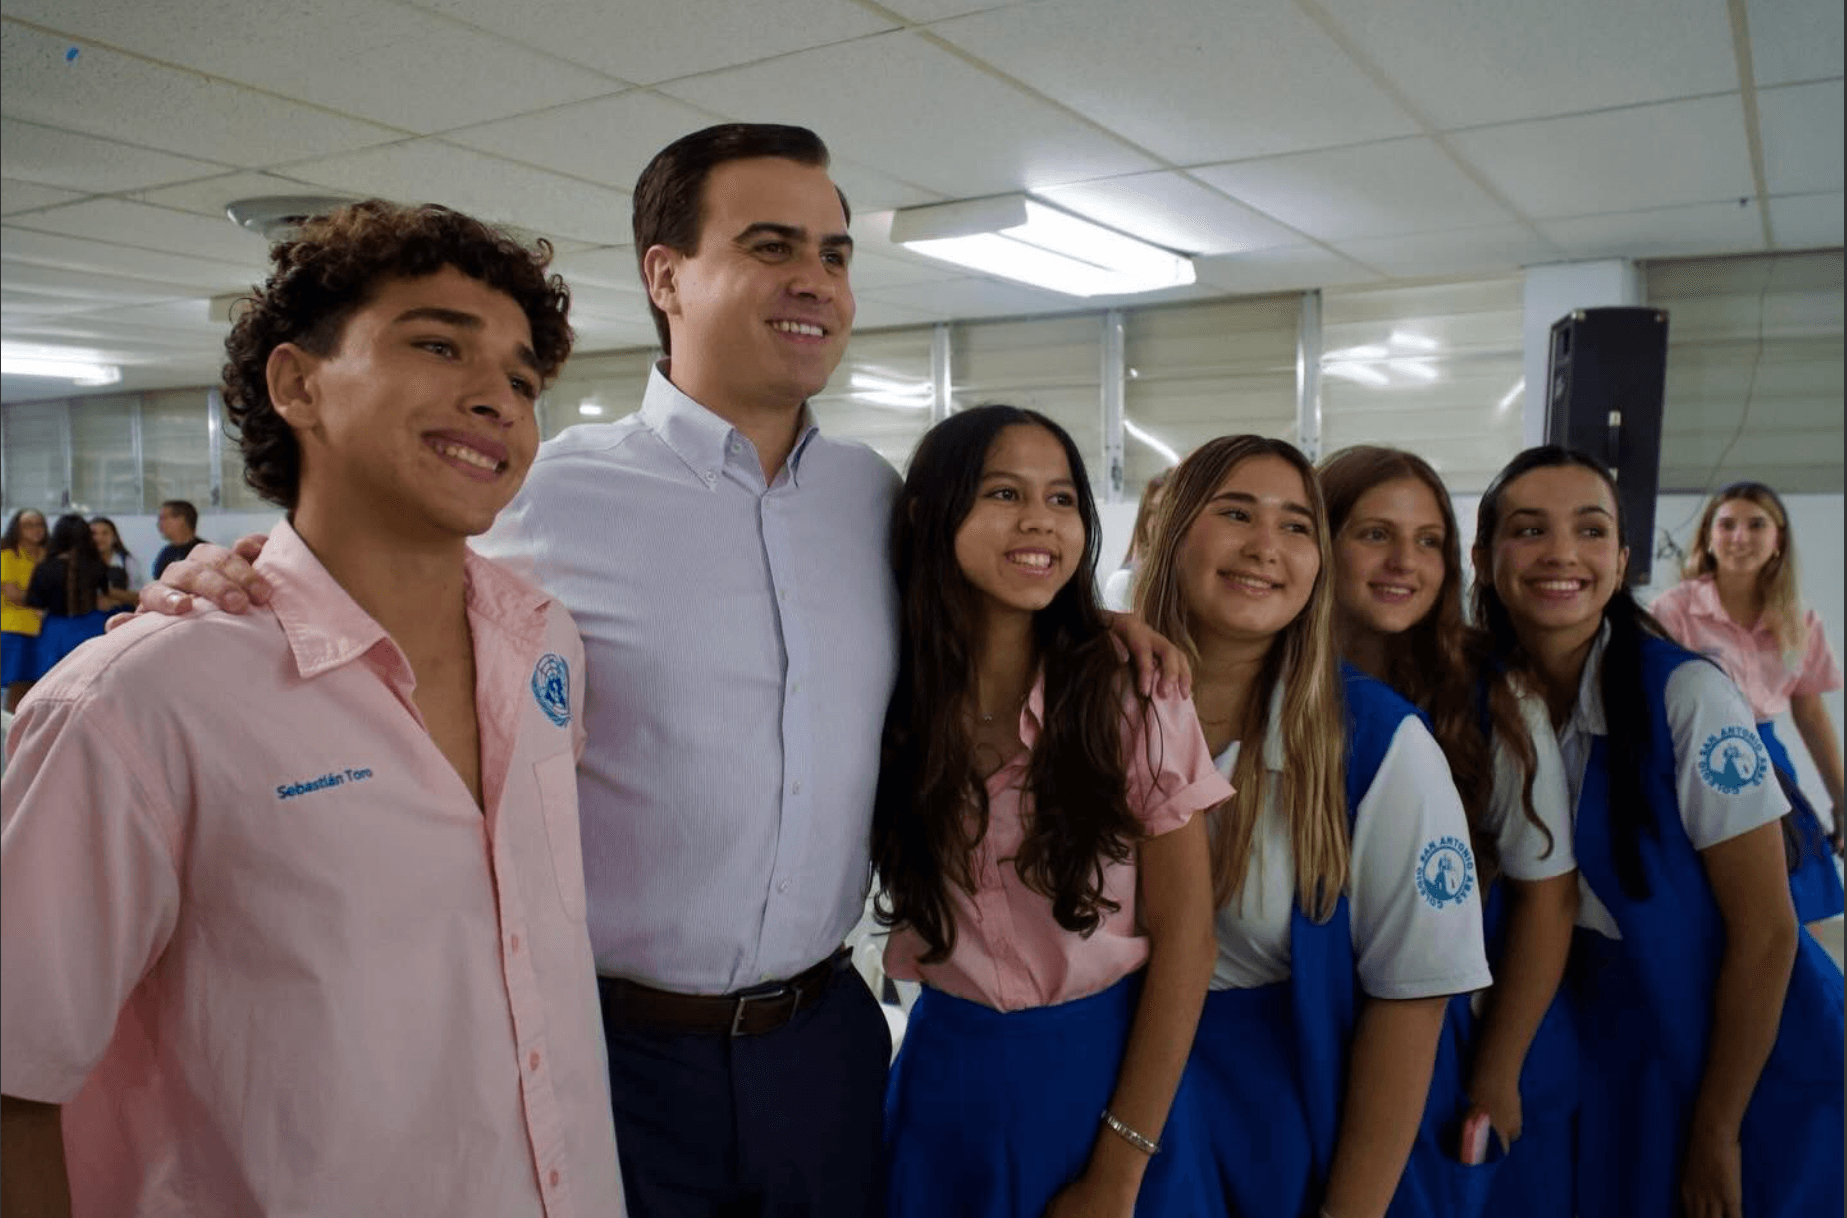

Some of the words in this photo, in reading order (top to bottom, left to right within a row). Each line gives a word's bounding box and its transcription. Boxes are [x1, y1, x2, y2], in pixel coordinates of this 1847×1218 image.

[1699, 733, 1717, 756] SAN
[1720, 726, 1763, 752] ANTONIO
[276, 772, 344, 799] Sebastián
[344, 767, 373, 782] Toro
[1420, 841, 1436, 862] SAN
[1440, 835, 1473, 870] ANTONIO
[1455, 875, 1474, 905] ABAD
